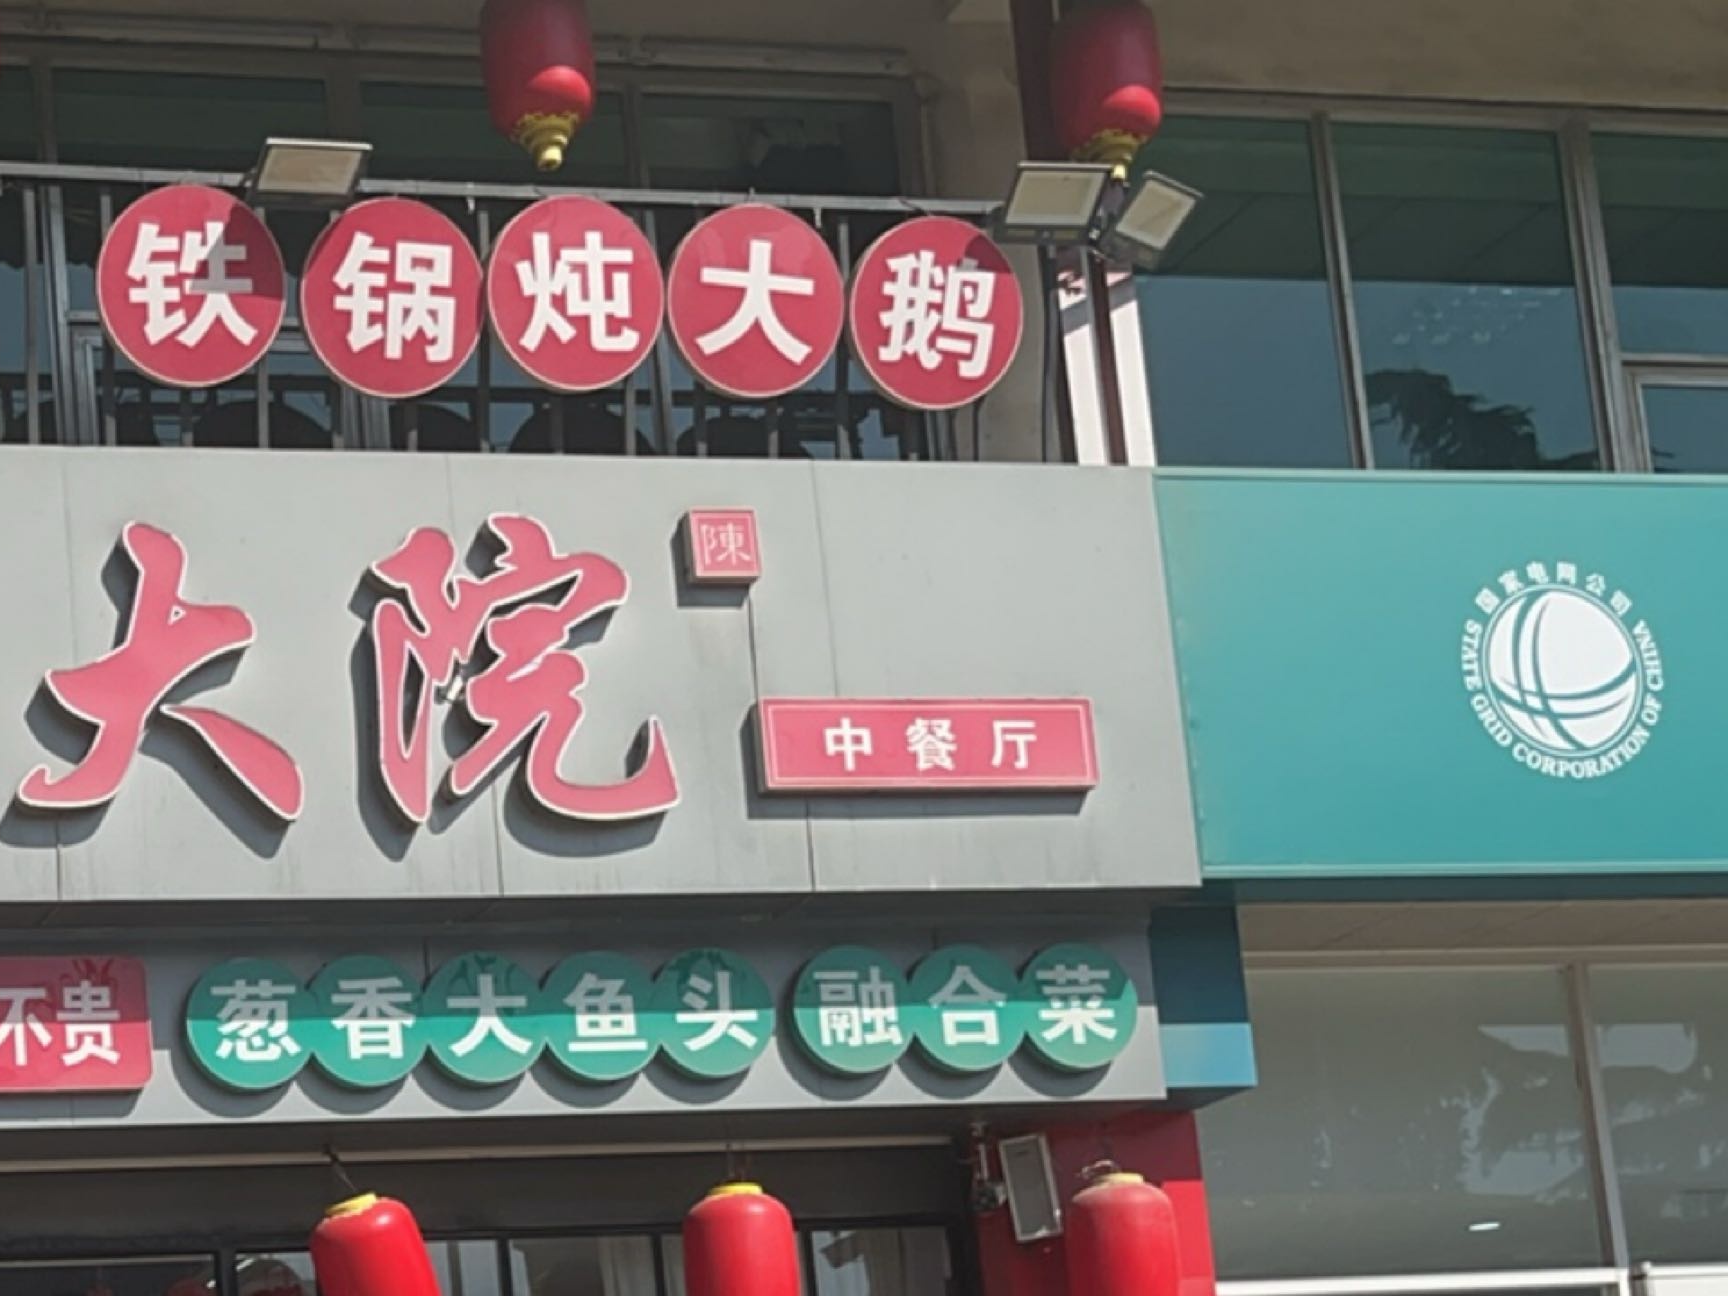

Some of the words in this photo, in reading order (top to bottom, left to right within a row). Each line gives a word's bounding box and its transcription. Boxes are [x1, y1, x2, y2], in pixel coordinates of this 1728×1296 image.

[126, 220, 997, 380] 铁锅炖大鹅
[1461, 619, 1483, 691] STATE
[1632, 619, 1665, 692] CHINA
[823, 716, 1039, 773] 中餐厅
[1470, 692, 1514, 748] GRID
[1640, 692, 1663, 726] OF
[1511, 723, 1651, 779] CORPORATION
[209, 970, 760, 1062] 葱香大鱼头
[813, 964, 1119, 1050] 融合菜
